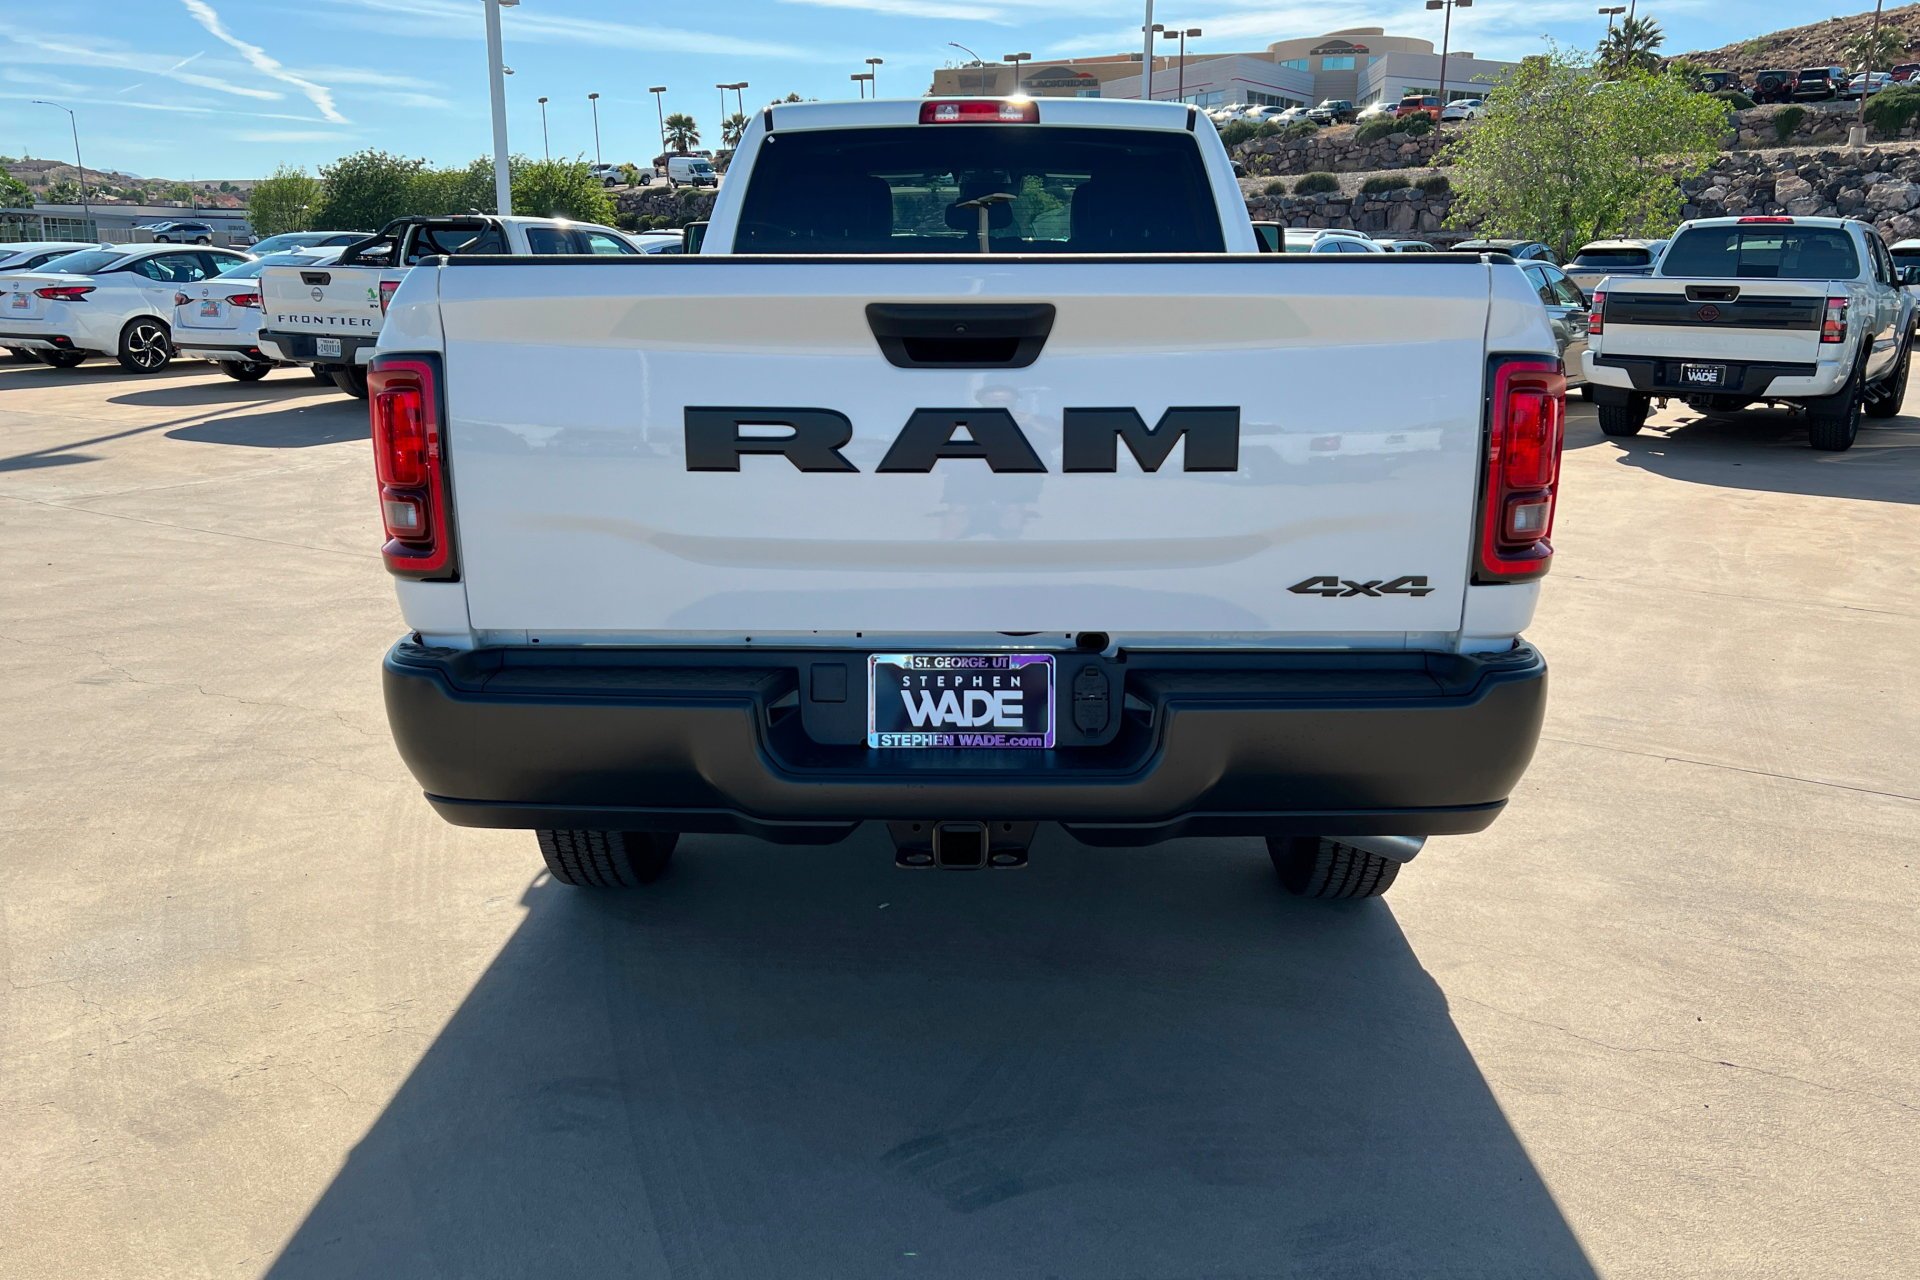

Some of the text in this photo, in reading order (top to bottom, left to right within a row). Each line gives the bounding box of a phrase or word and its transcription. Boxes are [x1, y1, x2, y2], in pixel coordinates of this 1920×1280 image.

[1020, 79, 1099, 89] BLACKRIDGE
[278, 315, 372, 326] FRONTIER
[1687, 371, 1718, 382] WADE
[684, 405, 1241, 474] RAM
[1286, 575, 1435, 597] 4x4
[915, 656, 1009, 669] ST. GEORGE, UT
[902, 675, 1021, 688] STEPHEN
[900, 689, 1024, 727] WADE
[881, 734, 1042, 747] STEPHEN WADE.com
